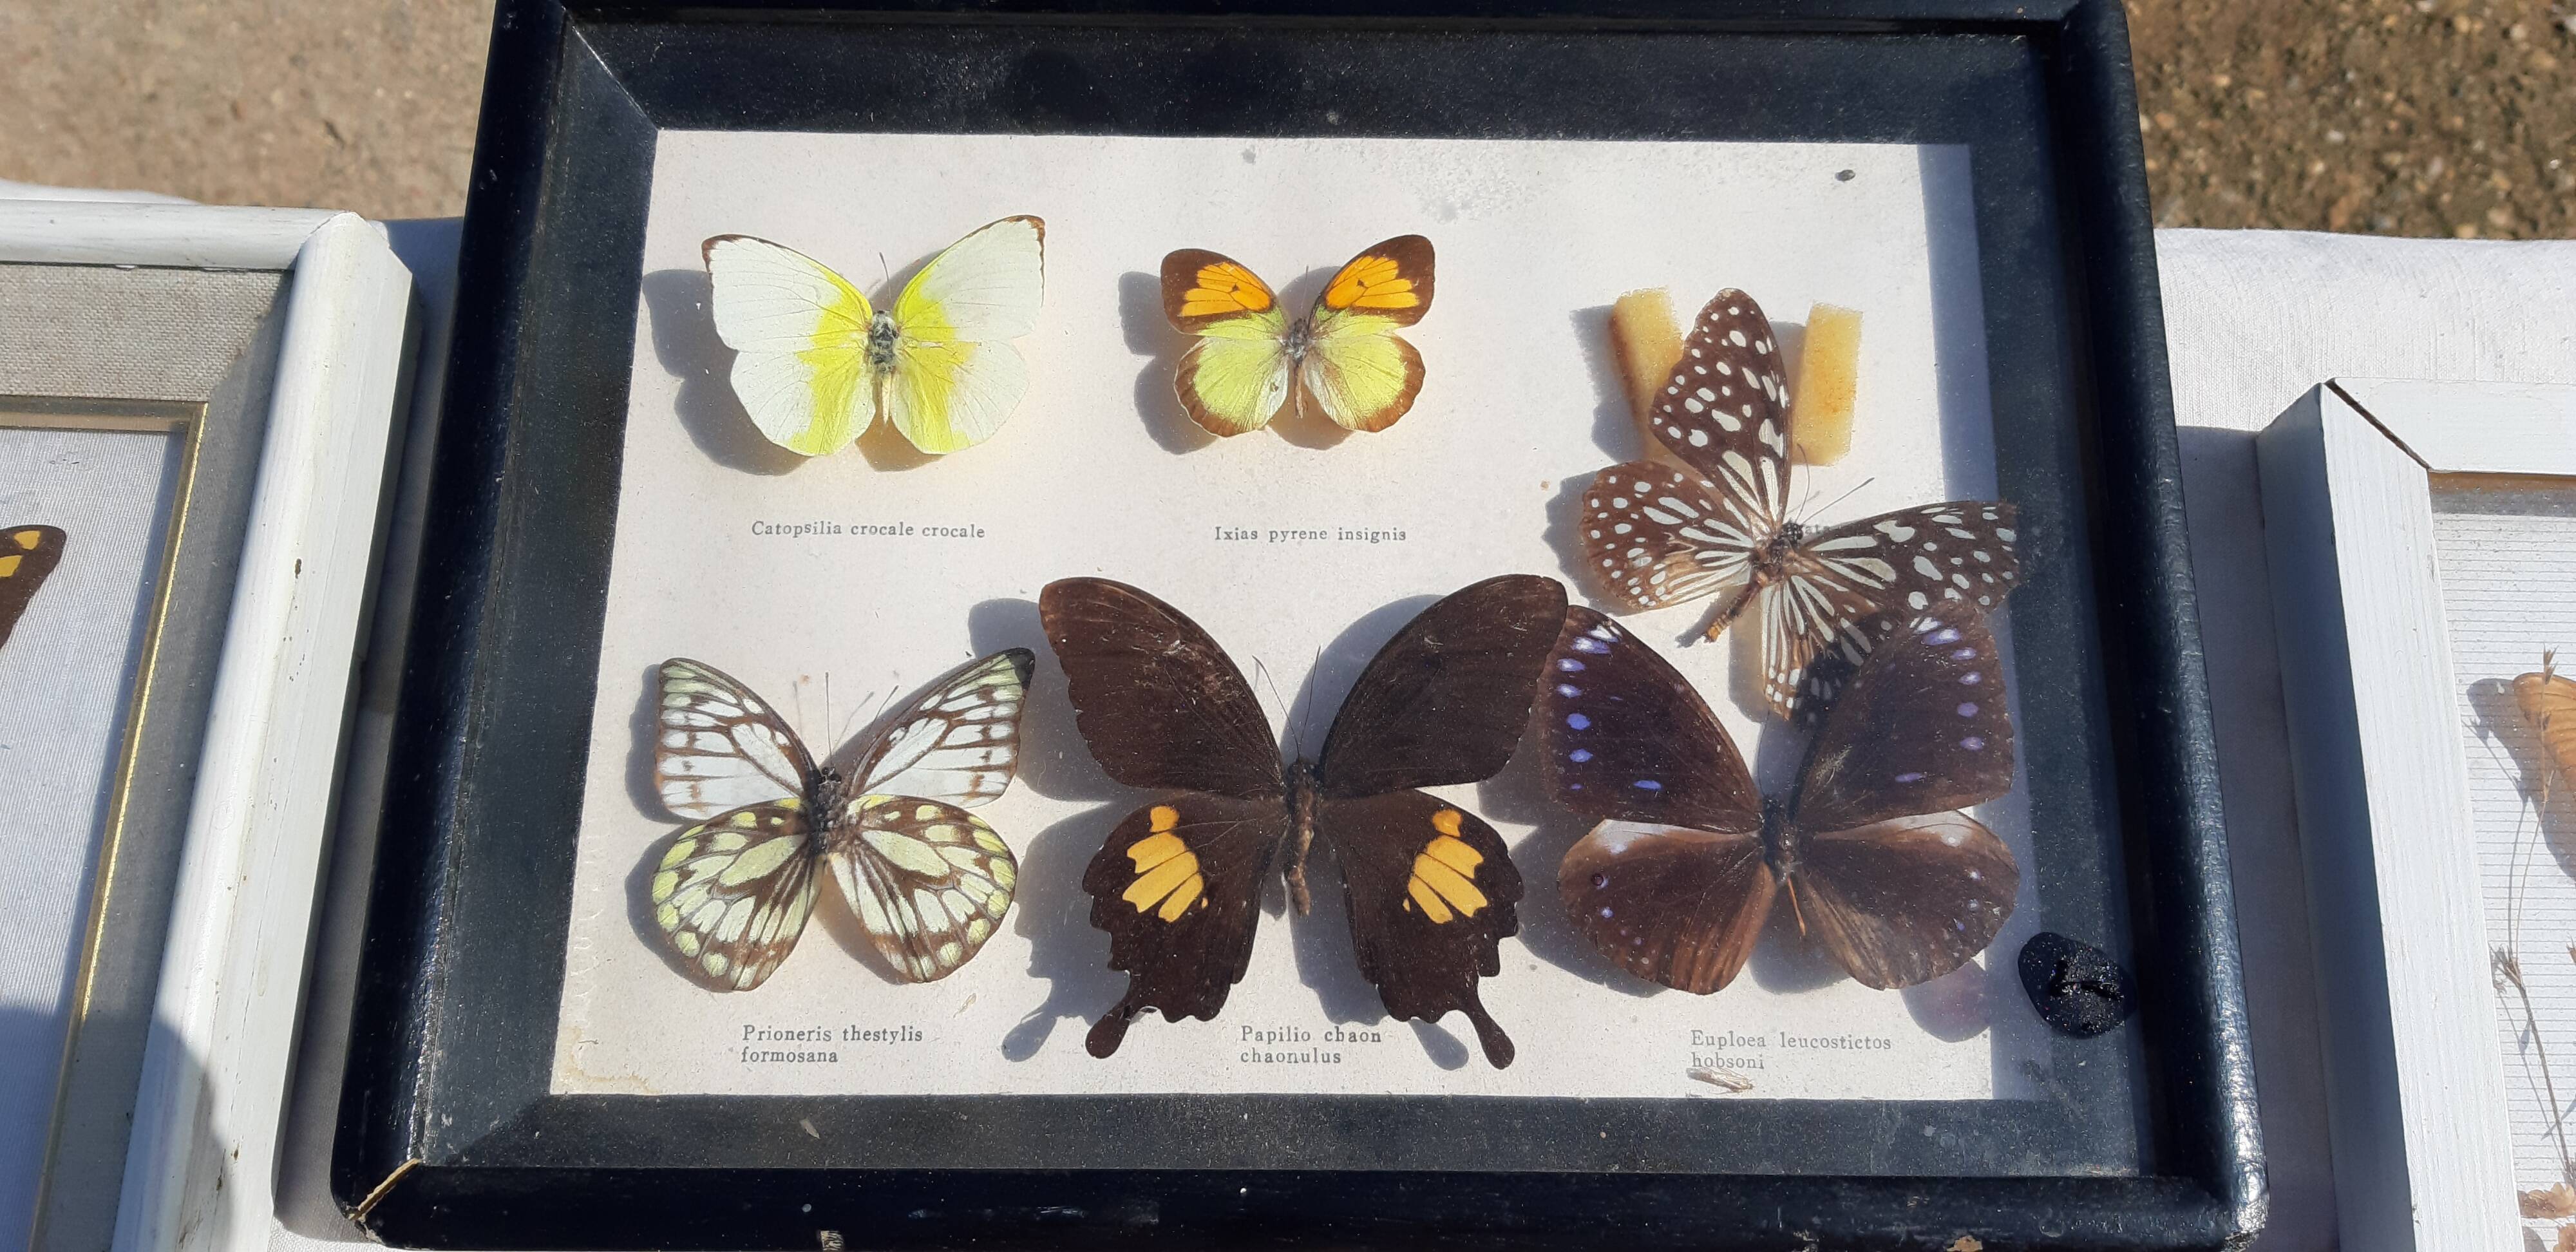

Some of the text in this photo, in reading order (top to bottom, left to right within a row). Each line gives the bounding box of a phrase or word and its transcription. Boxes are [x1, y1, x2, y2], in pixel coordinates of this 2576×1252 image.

[751, 520, 986, 538] Catopsilia crocale crocale
[1215, 526, 1406, 544] Ixias pyrene insignis
[742, 1025, 923, 1045] Prioneris thestylis
[1241, 1025, 1311, 1044] Papilio
[1690, 1029, 1892, 1050] Euploea leucostictos
[741, 1046, 838, 1063] formosana
[1240, 1047, 1341, 1063] chaonulus
[1691, 1052, 1765, 1070] hobsoni
